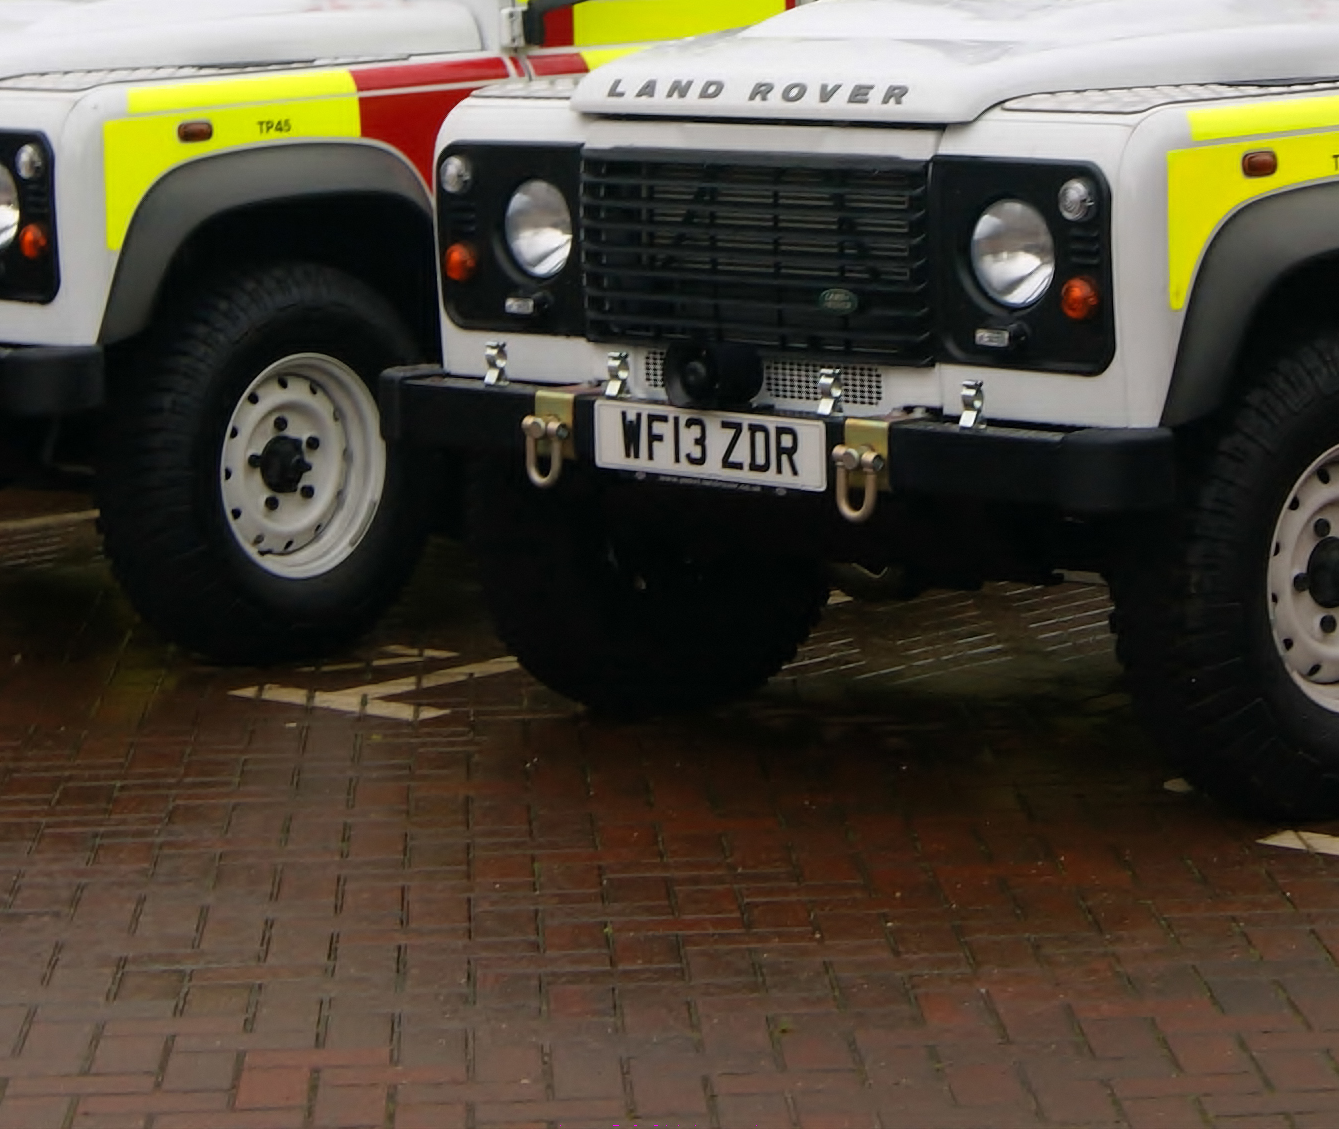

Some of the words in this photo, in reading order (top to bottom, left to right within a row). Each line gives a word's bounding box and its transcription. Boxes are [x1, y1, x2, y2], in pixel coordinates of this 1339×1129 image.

[607, 78, 725, 99] LAND
[748, 82, 910, 105] ROVER
[257, 118, 292, 135] TP45
[621, 411, 706, 466] WF13
[720, 420, 799, 476] ZDR
